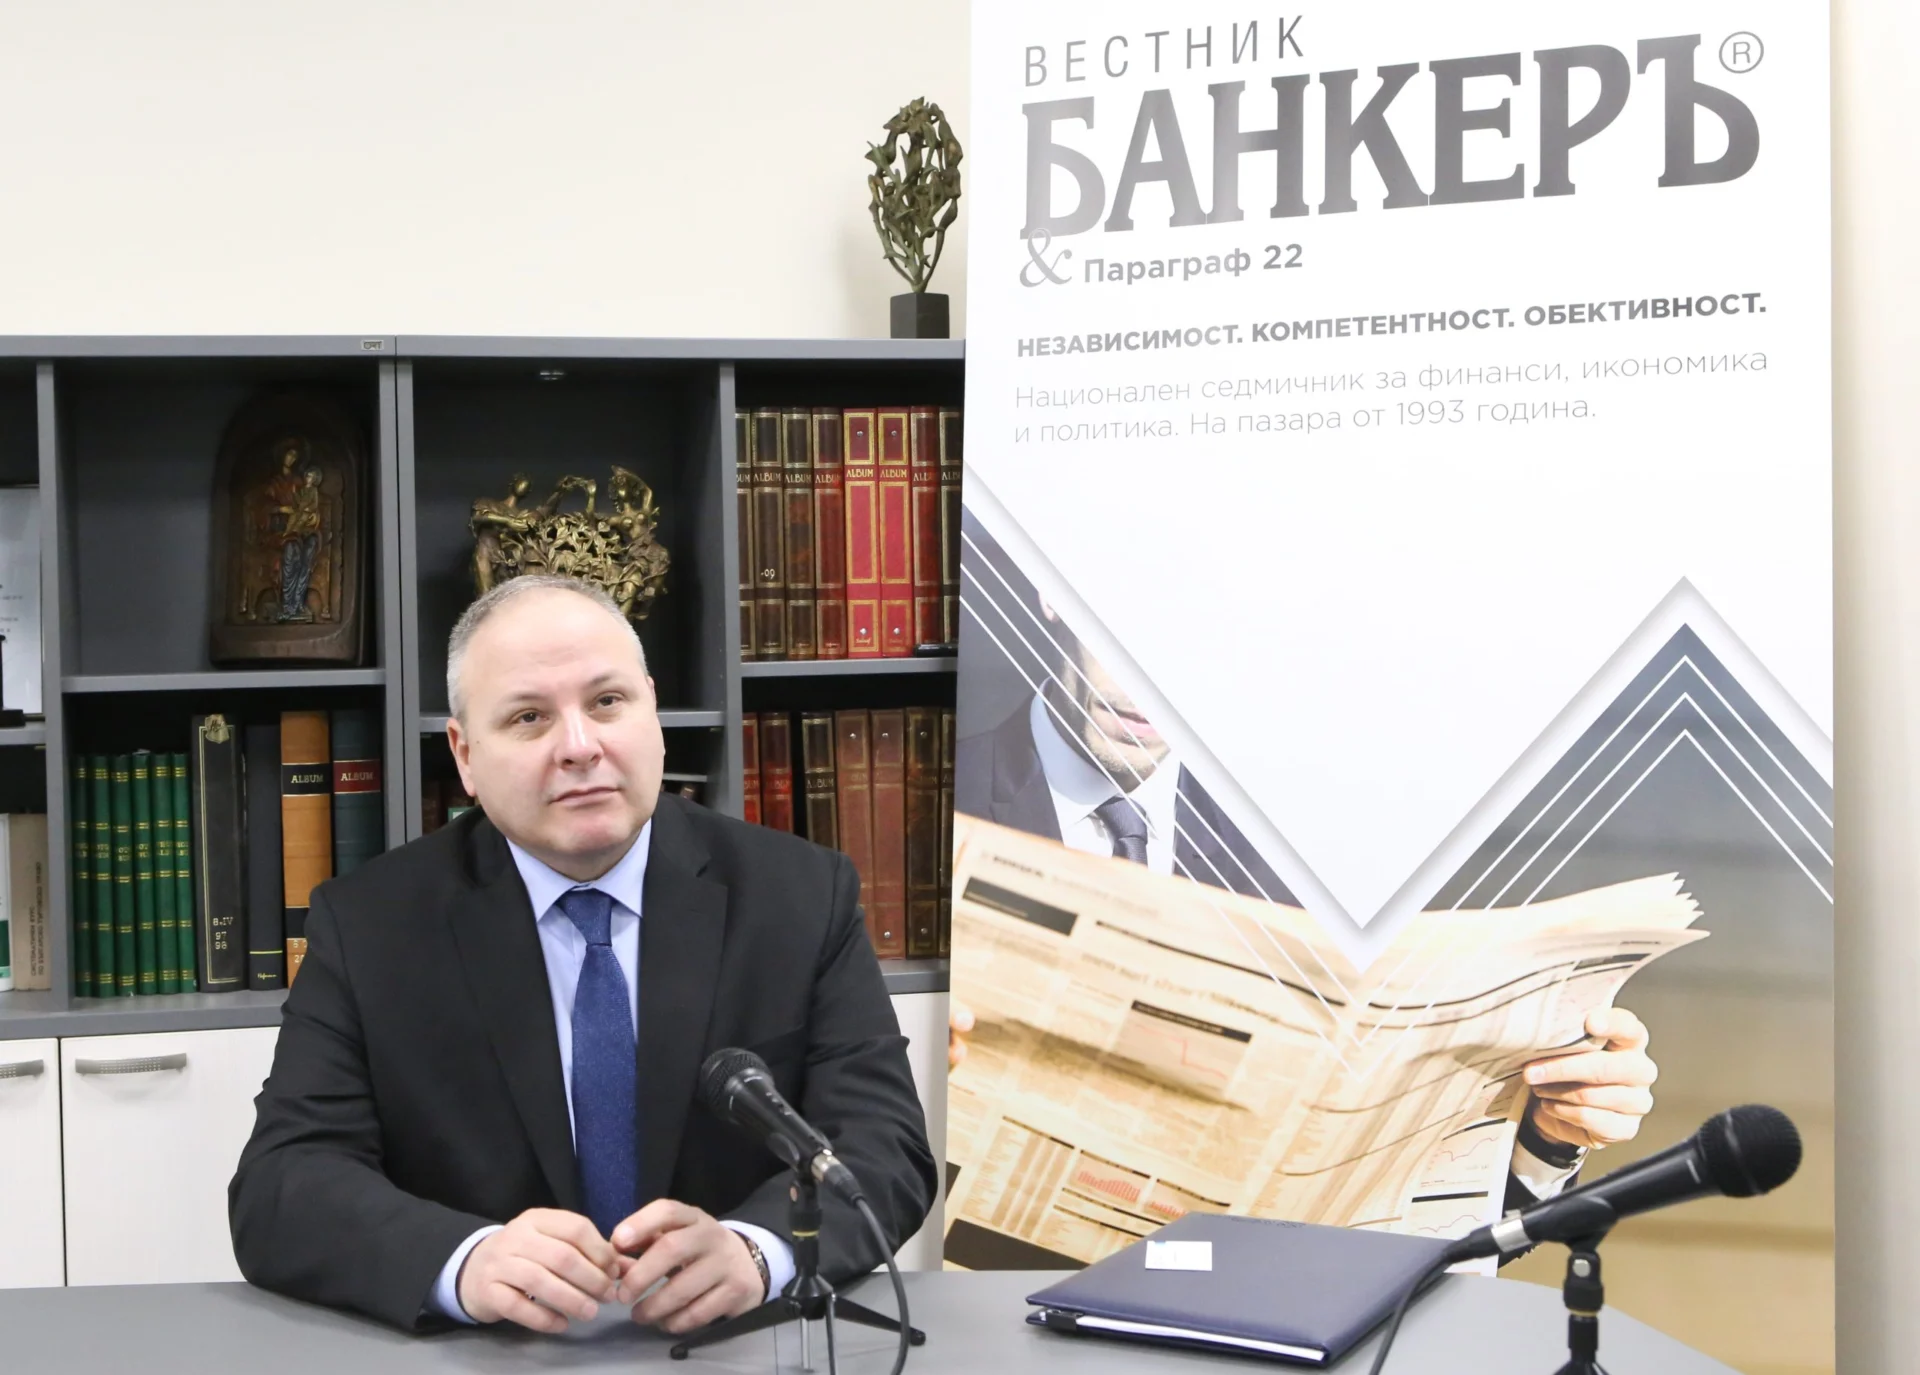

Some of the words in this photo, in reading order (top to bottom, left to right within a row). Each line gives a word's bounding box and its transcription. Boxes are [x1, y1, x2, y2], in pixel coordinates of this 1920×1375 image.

[1024, 15, 1305, 87] ВЕСТНИК
[1019, 33, 1760, 241] БАНКЕРЪ
[1083, 248, 1252, 286] Параграф
[1262, 243, 1304, 271] 22
[1017, 323, 1244, 358] НЕЗАВИСИМОСТ.
[1251, 307, 1516, 343] КОМПЕТЕНТНОСТ.
[1523, 292, 1767, 327] ОБЕКТИВНОСТ.
[1016, 384, 1190, 411] Национален
[1201, 372, 1365, 402] седмичник
[1375, 371, 1407, 391] за
[1418, 362, 1570, 393] финанси,
[1582, 351, 1768, 379] икономика
[1015, 426, 1030, 444] и
[1040, 419, 1179, 443] политика.
[1190, 412, 1226, 435] На
[1238, 412, 1341, 435] пазара
[1352, 409, 1386, 428] от
[1396, 400, 1465, 426] 1993
[1477, 399, 1597, 427] година.
[753, 472, 782, 483] ALBUM
[785, 473, 812, 484] ALBUM
[846, 468, 874, 478] ALBUM
[880, 469, 908, 478] ALBUM
[290, 774, 324, 784] ALBUM
[341, 771, 374, 782] ALBUM
